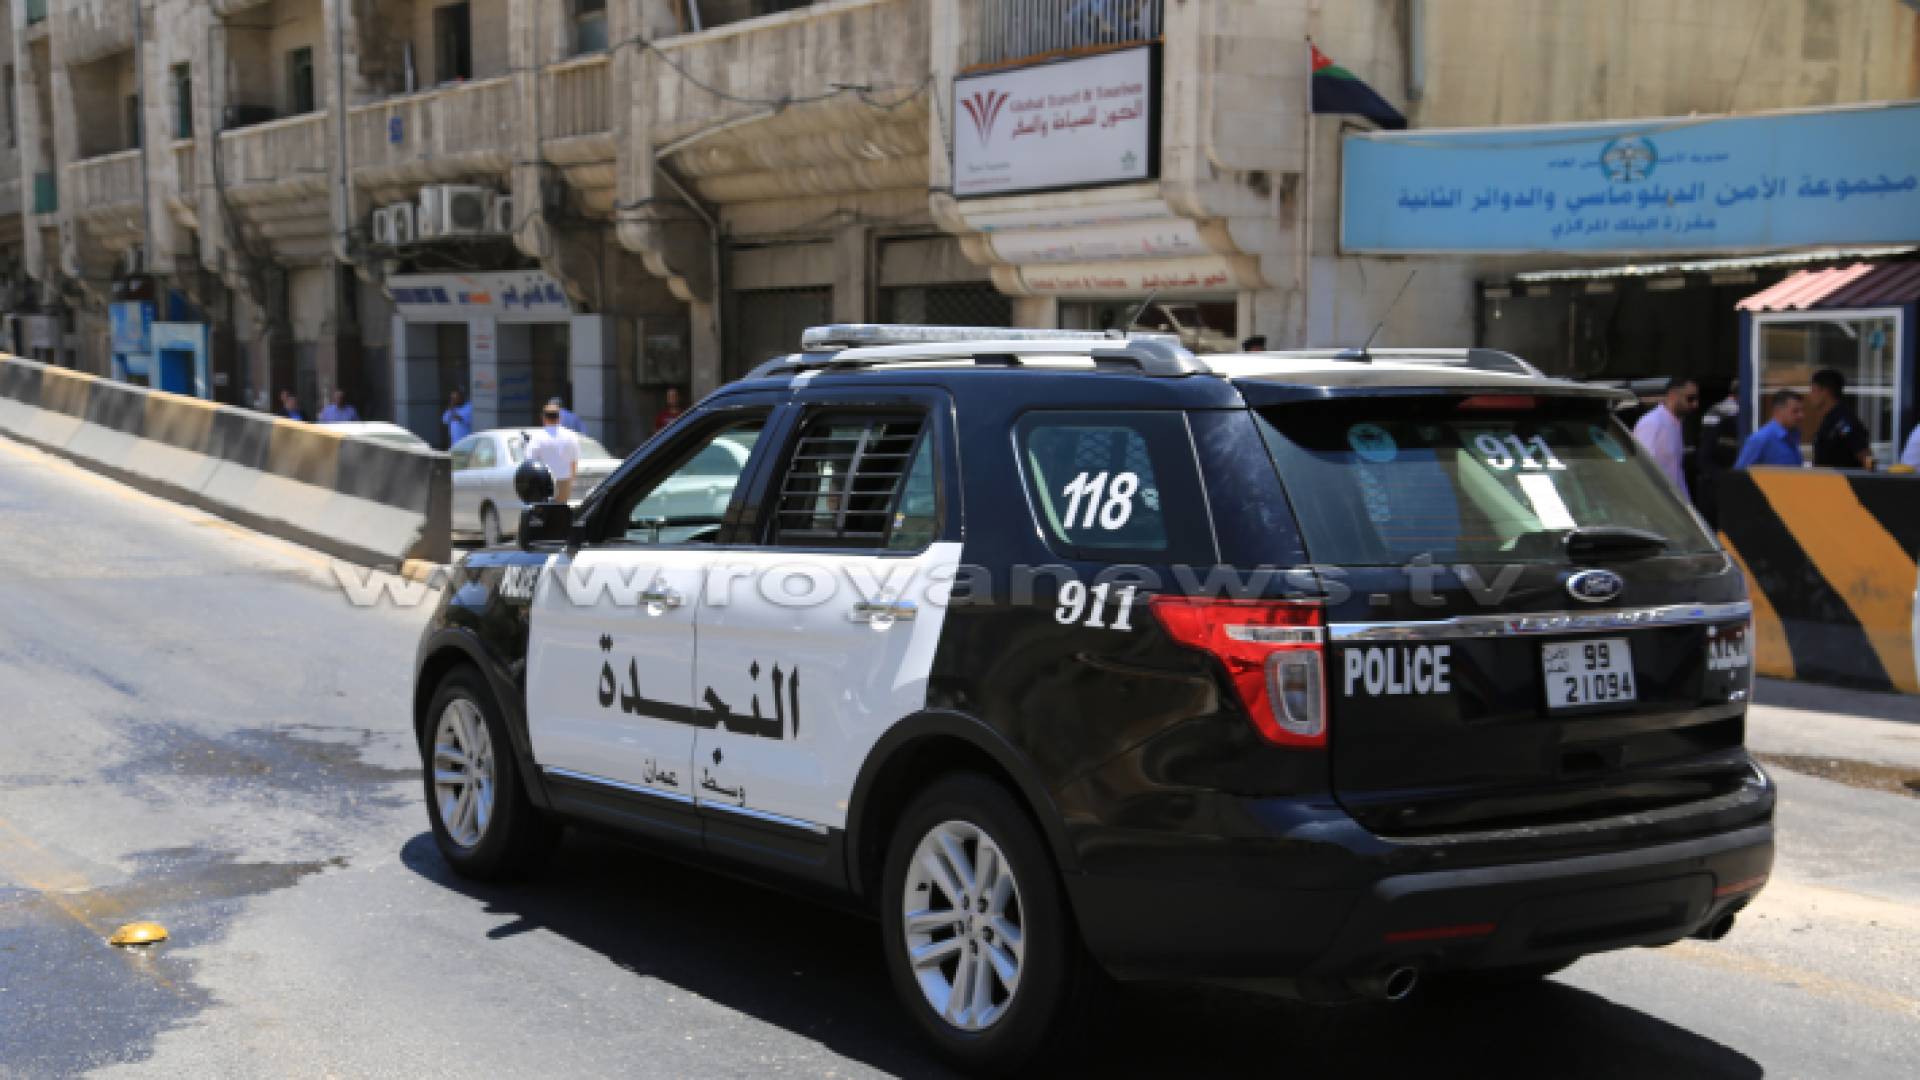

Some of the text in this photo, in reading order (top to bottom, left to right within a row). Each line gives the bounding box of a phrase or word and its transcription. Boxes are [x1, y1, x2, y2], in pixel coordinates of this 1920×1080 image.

[1566, 182, 1705, 215] الدبلوماسي
[1715, 173, 1786, 208] الأمن
[1798, 174, 1918, 203] مجموعة
[1473, 433, 1568, 471] 911
[1063, 471, 1140, 530] 118
[1055, 580, 1138, 632] 911
[1343, 645, 1451, 698] POLICE
[1584, 642, 1610, 670] 99
[599, 633, 800, 766] النجدة
[1564, 671, 1633, 703] 21094
